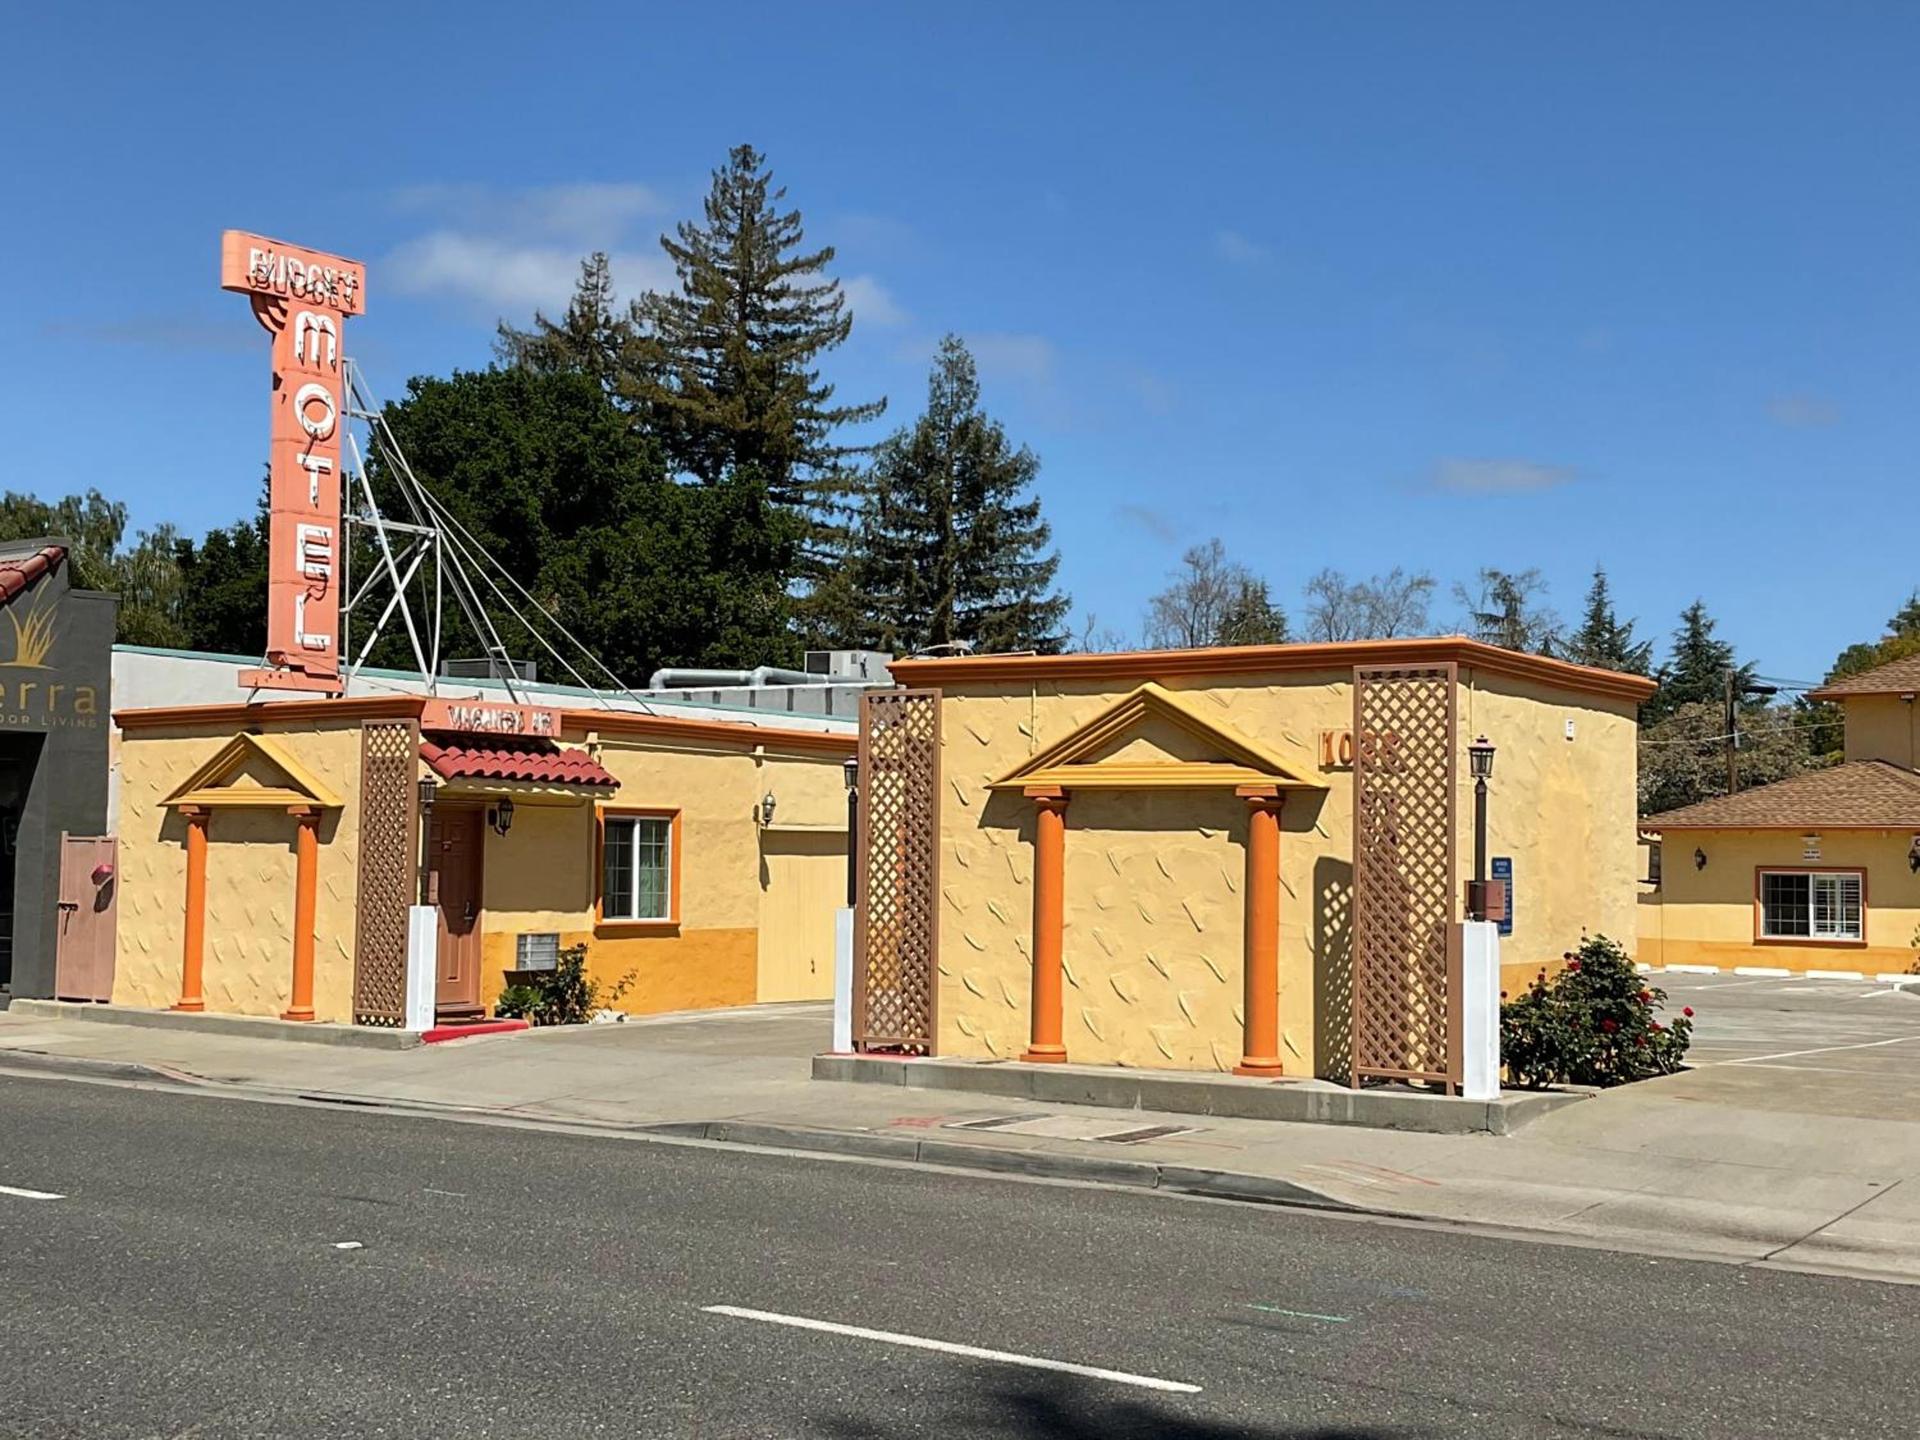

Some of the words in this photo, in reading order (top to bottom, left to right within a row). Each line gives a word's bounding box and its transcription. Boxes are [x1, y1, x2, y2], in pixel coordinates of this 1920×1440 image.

[249, 247, 357, 306] BUDGET
[293, 310, 337, 649] MOTEL
[0, 681, 97, 715] rra
